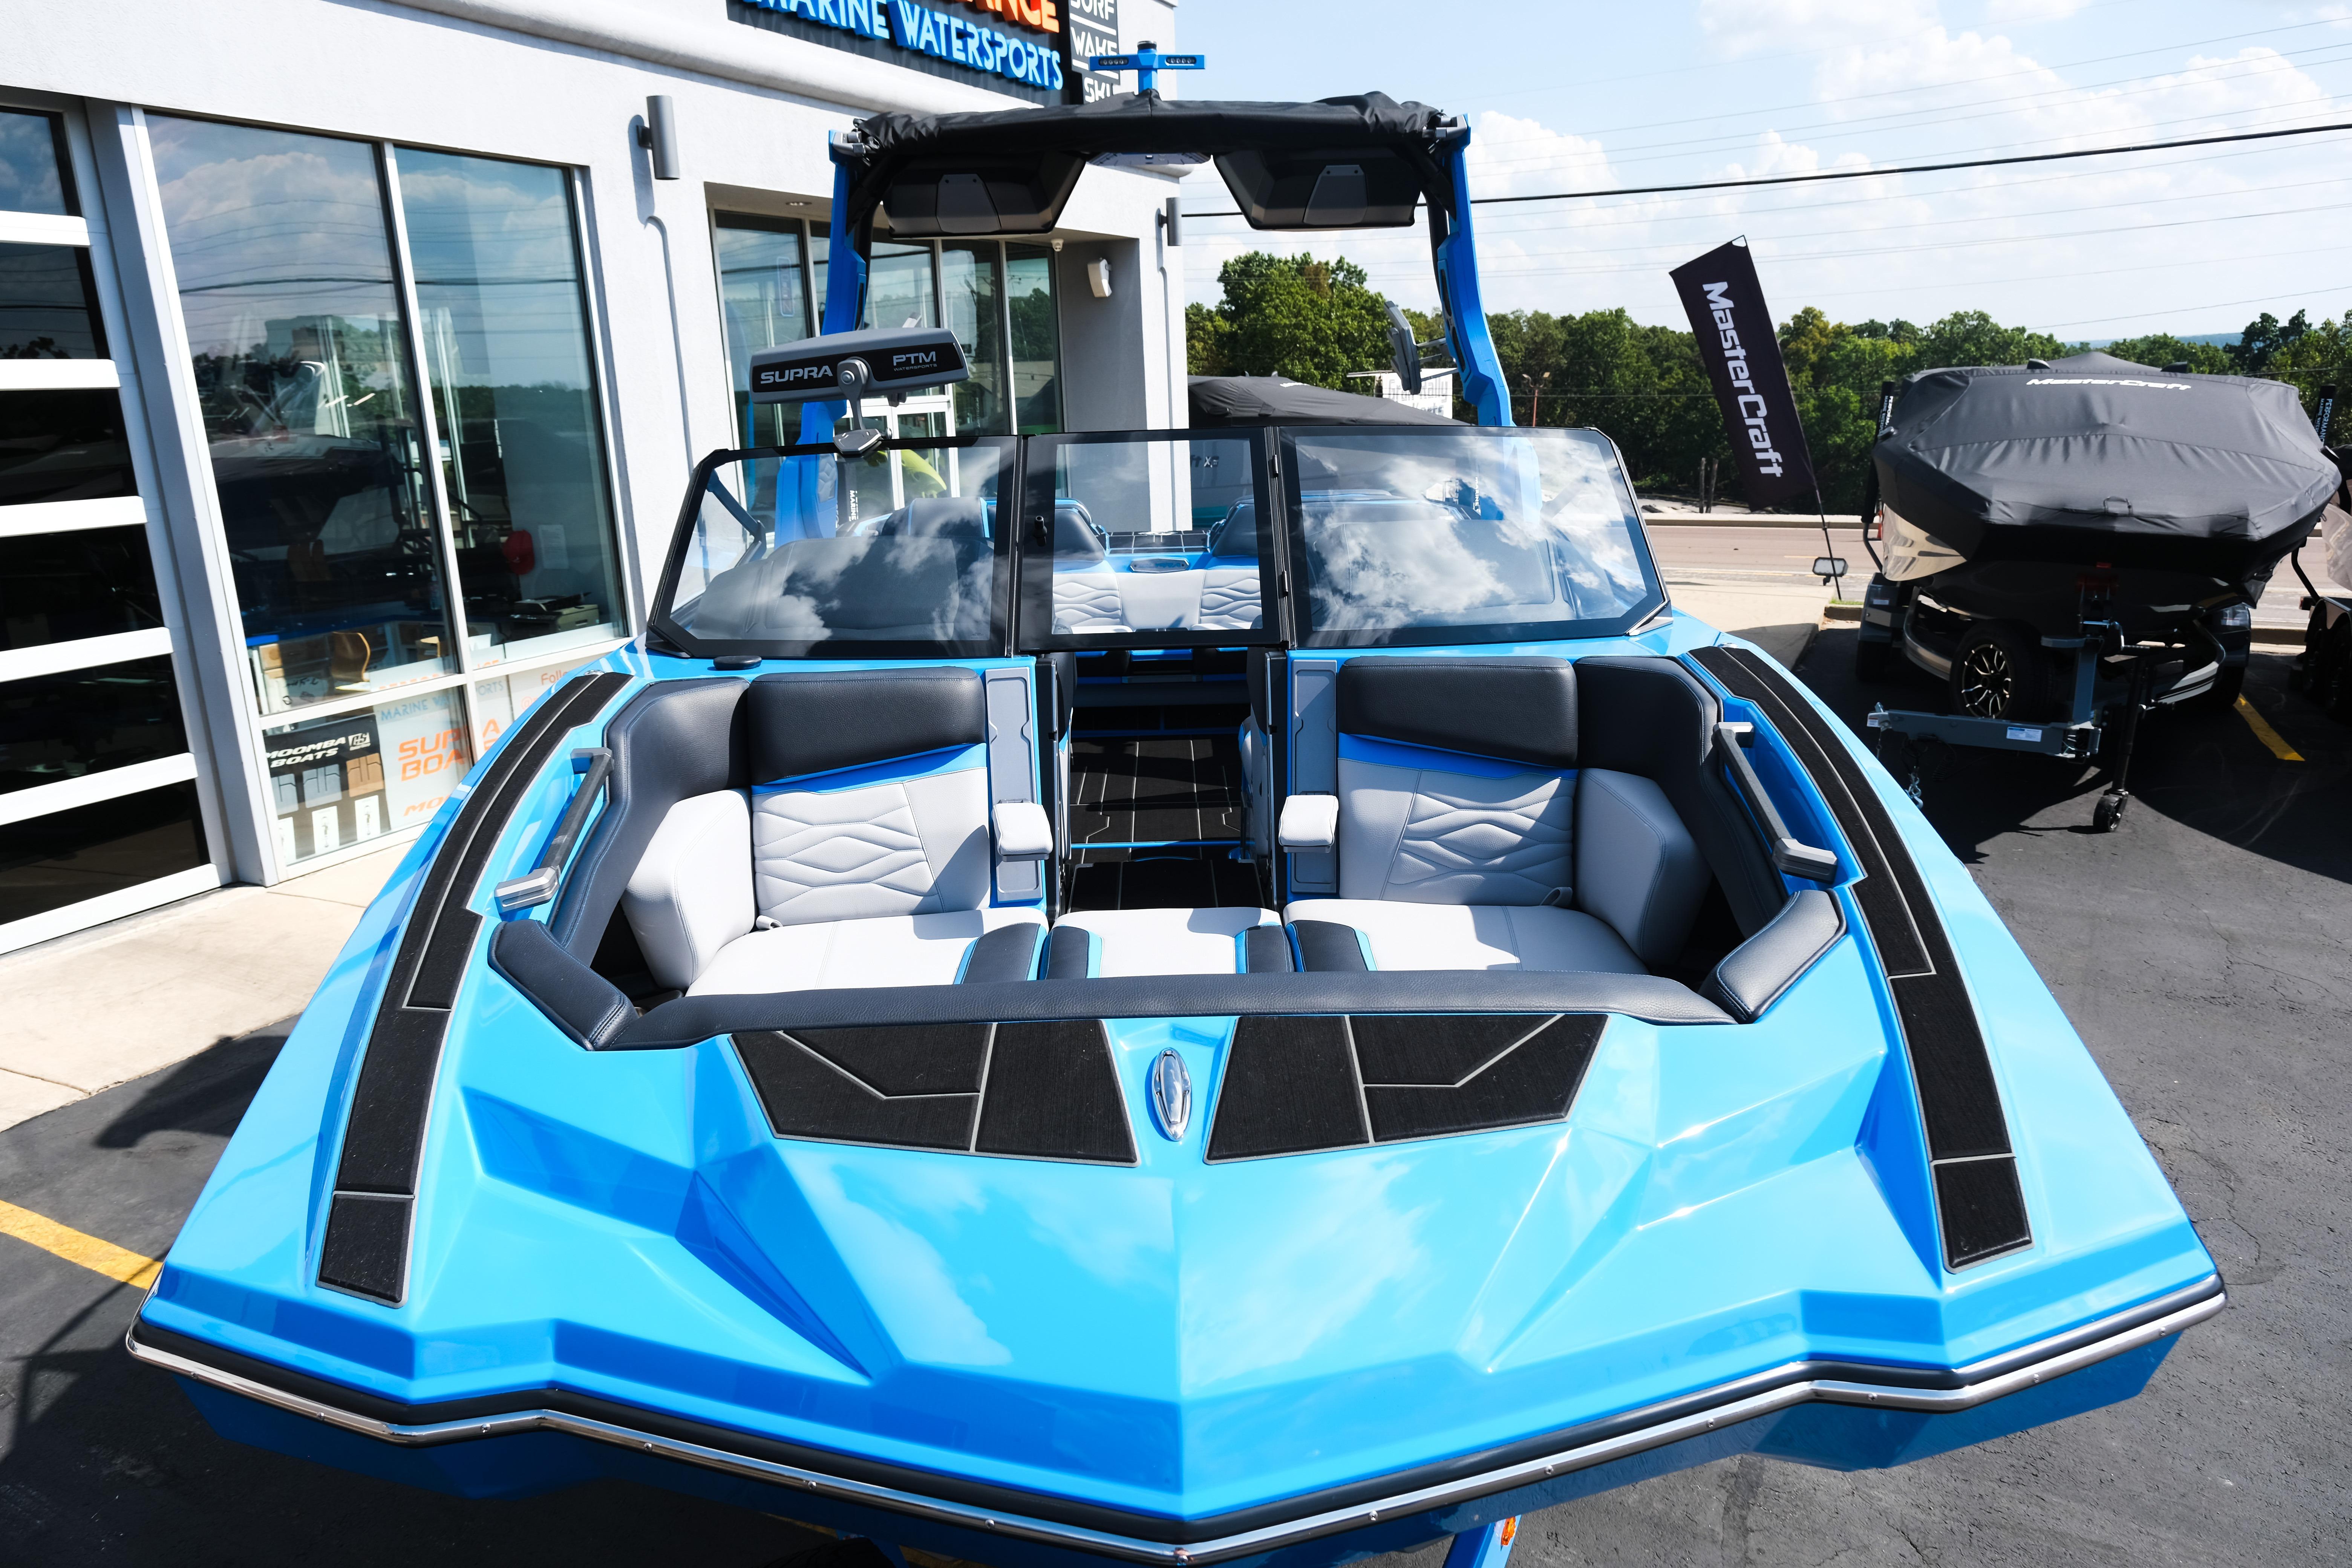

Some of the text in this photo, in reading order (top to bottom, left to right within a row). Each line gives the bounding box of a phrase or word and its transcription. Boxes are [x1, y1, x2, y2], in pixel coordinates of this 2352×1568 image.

[897, 0, 1064, 90] WATERSPORTS
[1070, 26, 1118, 57] WAKE
[1084, 77, 1110, 103] SKI
[893, 351, 937, 366] PTM
[894, 363, 937, 372] WATERSPORTS
[760, 365, 833, 384] SUPRA
[1702, 281, 1784, 478] MasterCraft
[2026, 378, 2191, 390] MasterCraft
[2320, 398, 2332, 444] PERFORMANC
[381, 699, 428, 721] MARINE
[266, 737, 346, 759] MOOMBA
[270, 747, 338, 768] BOATS
